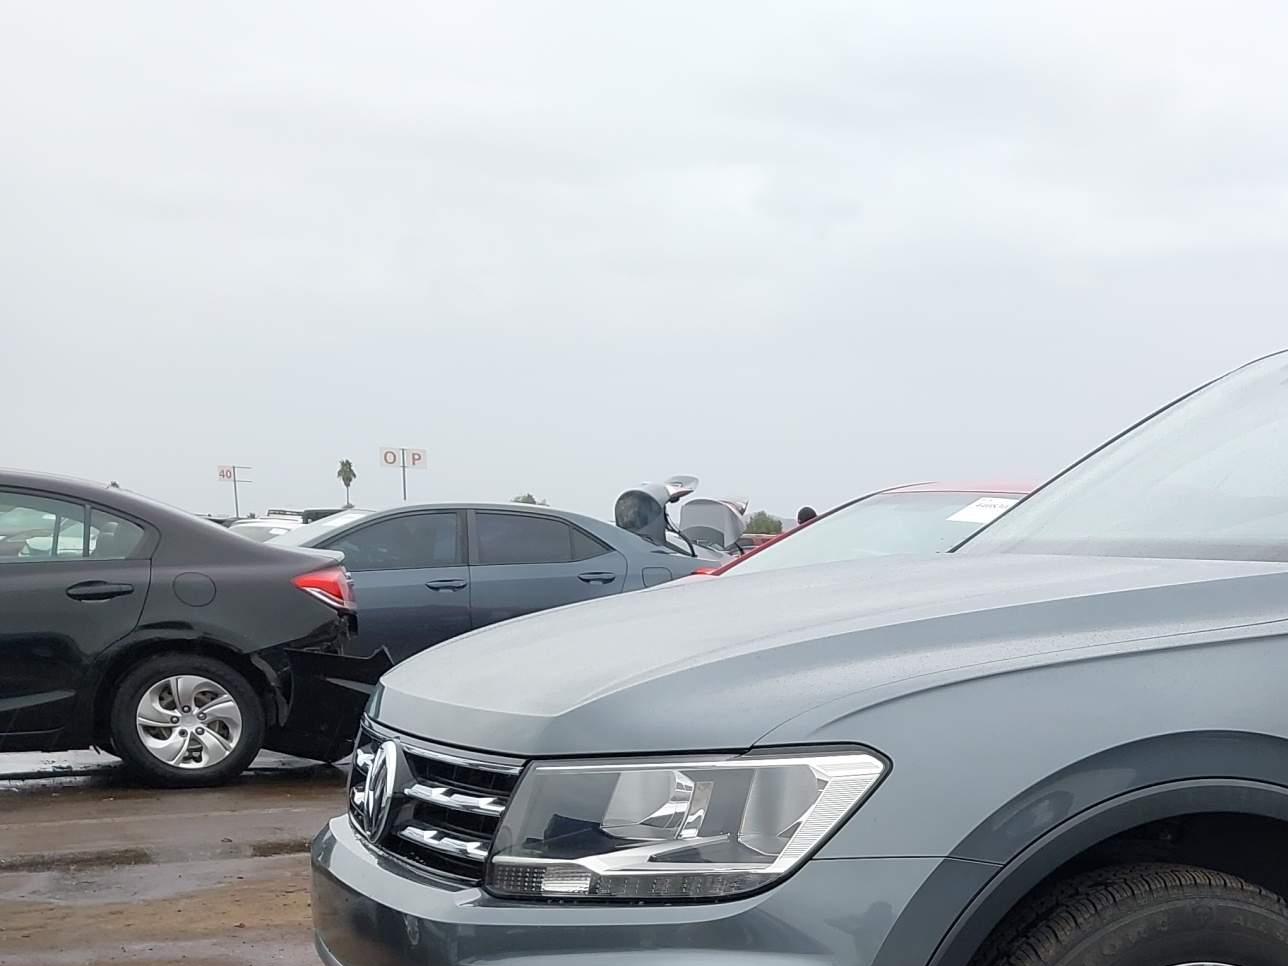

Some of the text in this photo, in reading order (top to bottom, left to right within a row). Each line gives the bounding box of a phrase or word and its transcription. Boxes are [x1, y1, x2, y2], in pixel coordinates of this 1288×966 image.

[383, 450, 397, 465] O
[411, 452, 422, 466] P
[218, 469, 232, 479] 40
